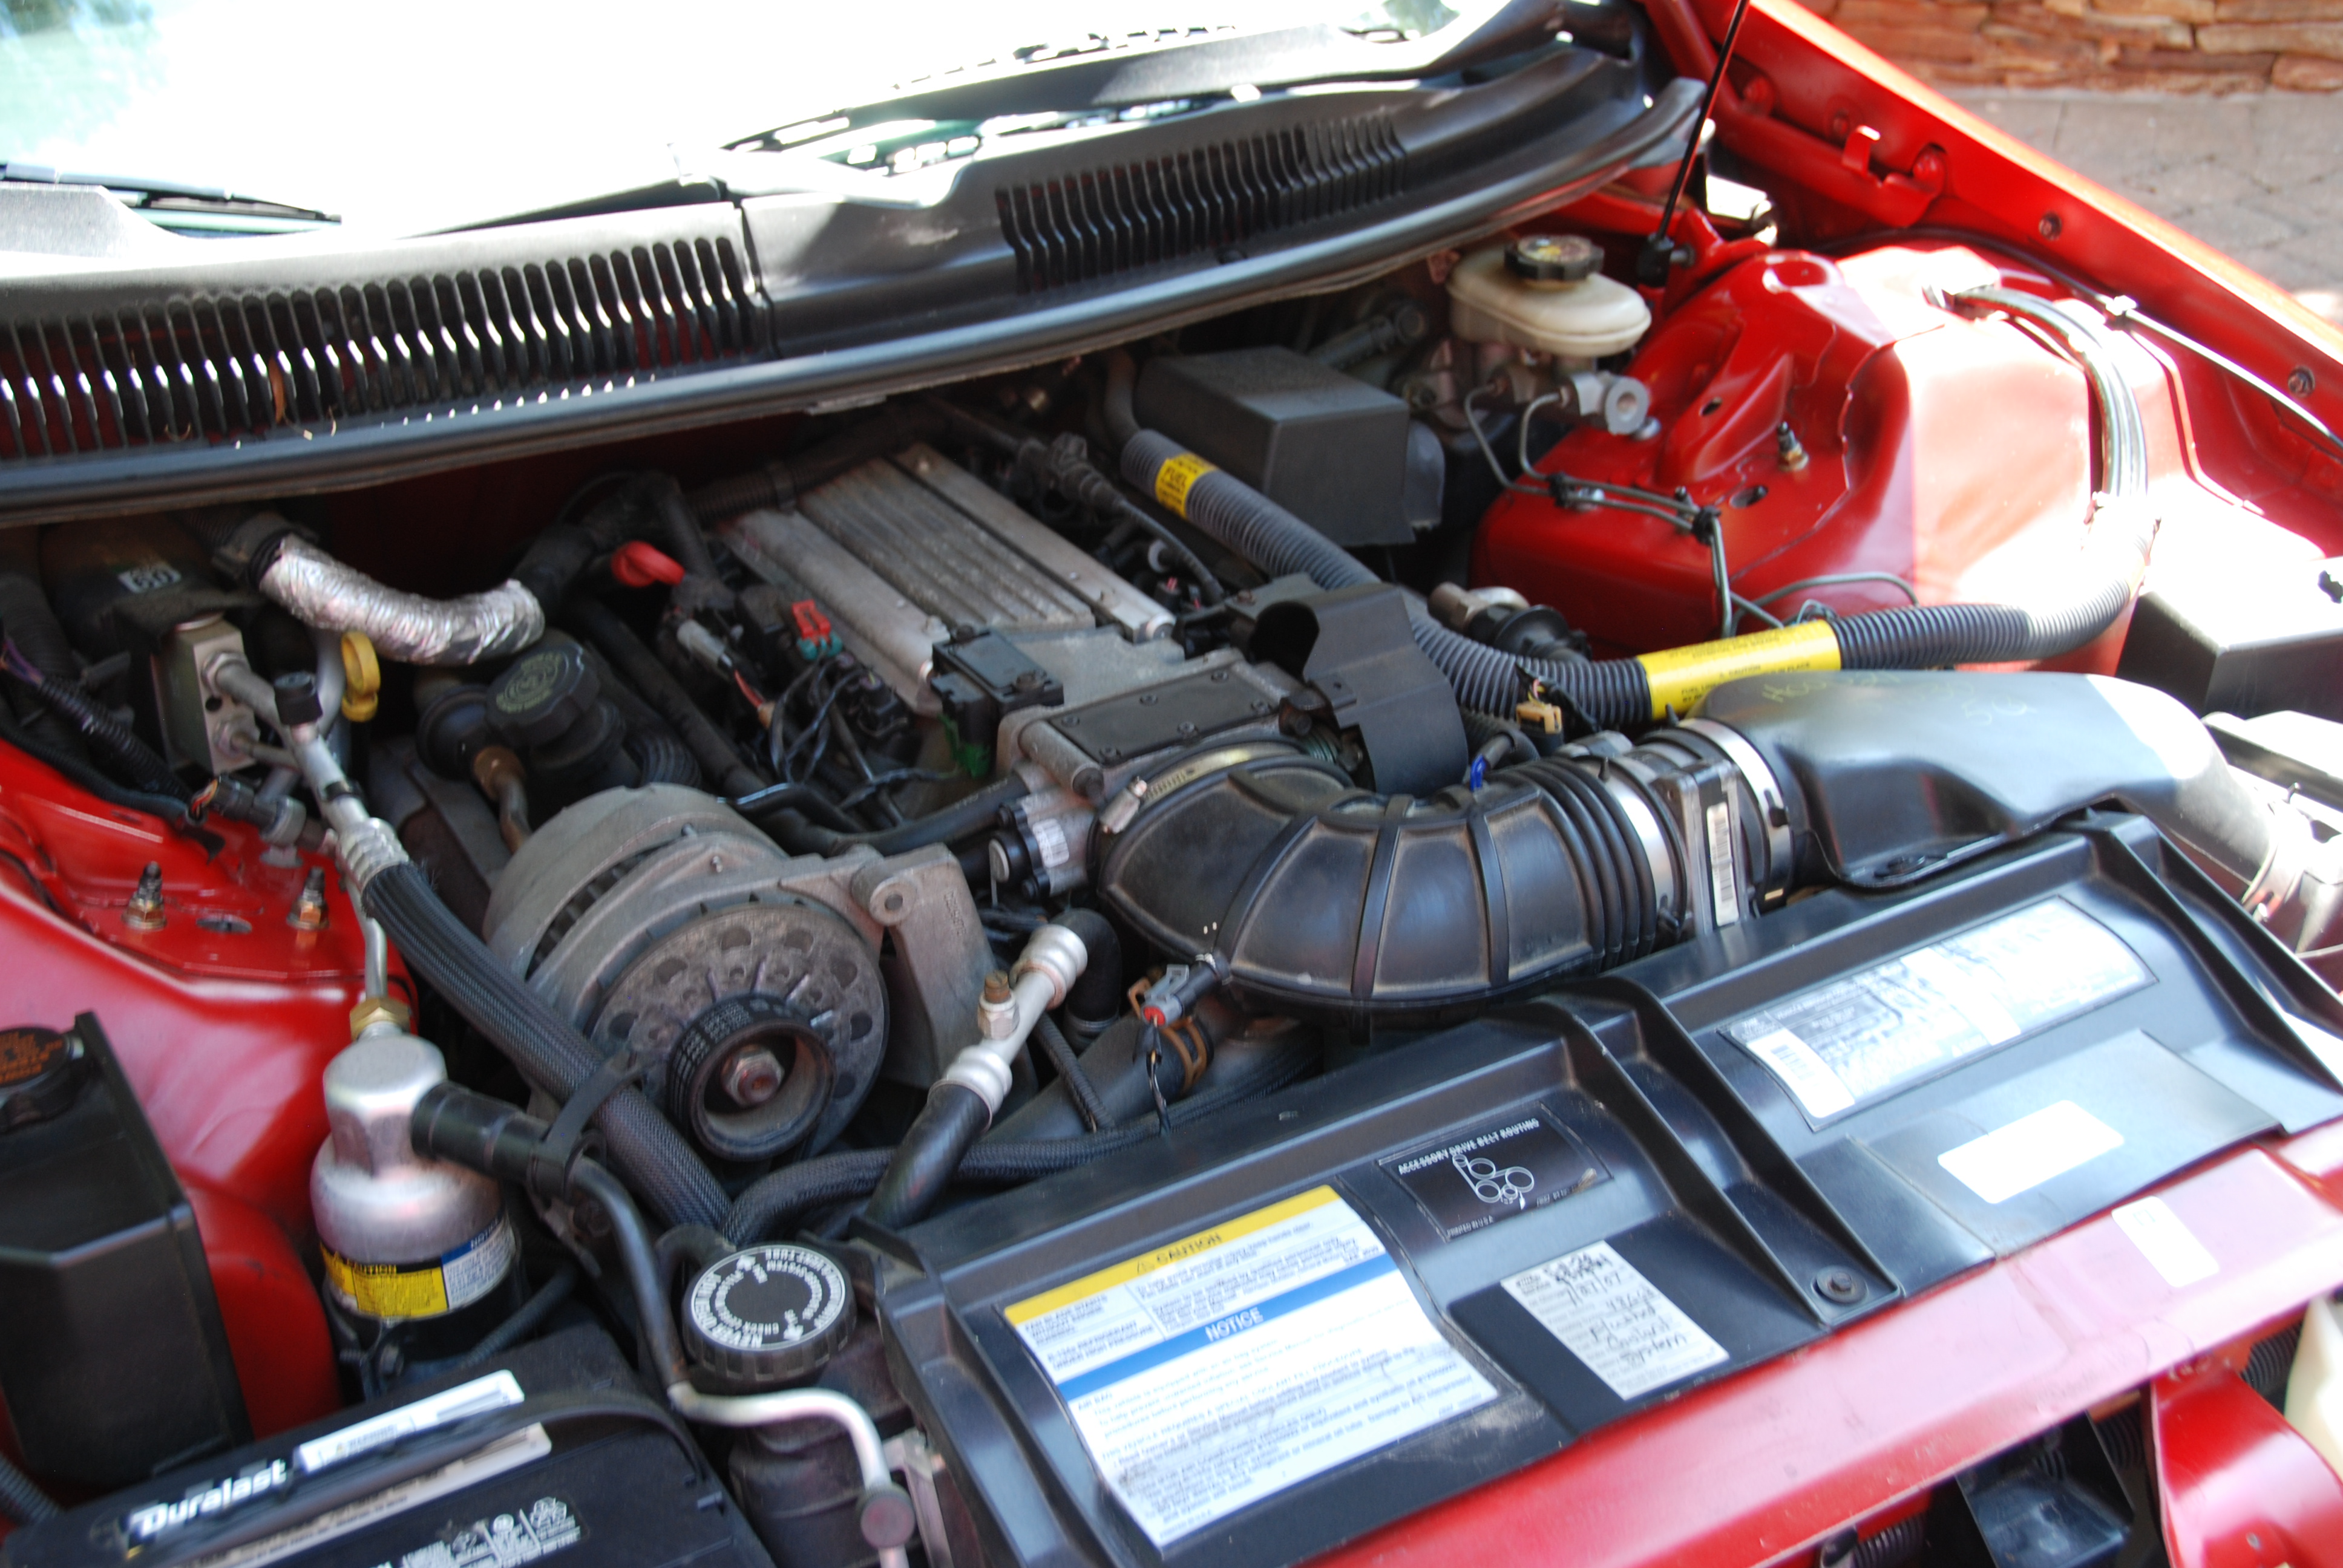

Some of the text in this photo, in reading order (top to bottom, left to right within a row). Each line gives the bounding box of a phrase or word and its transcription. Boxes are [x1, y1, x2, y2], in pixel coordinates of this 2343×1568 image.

[1162, 465, 1190, 488] FUEL
[1728, 664, 1761, 677] CAUTION
[1397, 1117, 1540, 1175] ACCESSORY DRIVE BELT ROUTING
[1155, 1230, 1224, 1267] CAUTION
[1204, 1305, 1265, 1343] NOTICE
[128, 1458, 289, 1537] Duralast
